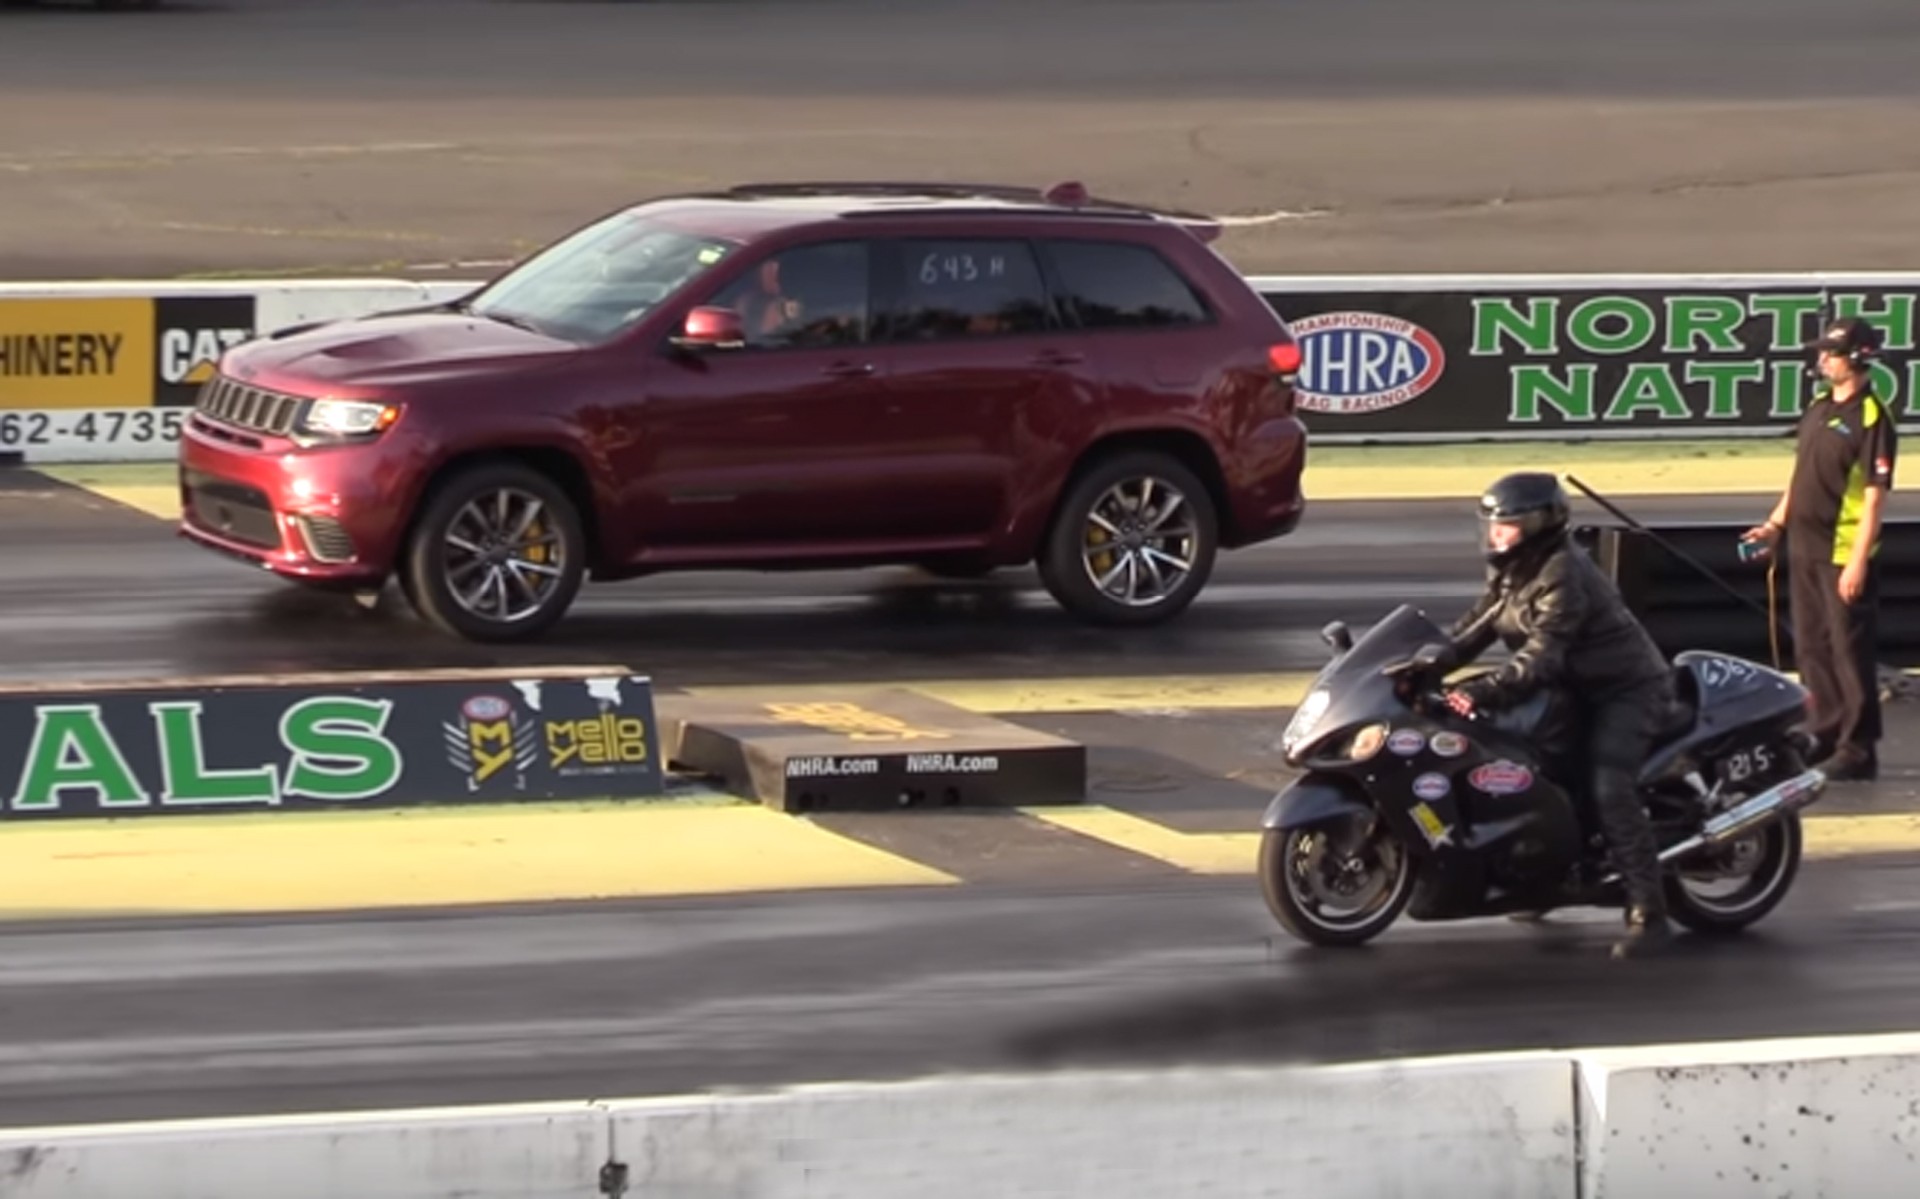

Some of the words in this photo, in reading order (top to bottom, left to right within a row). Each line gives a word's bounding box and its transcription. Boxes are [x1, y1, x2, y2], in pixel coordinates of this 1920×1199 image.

[920, 253, 978, 284] 643
[1292, 313, 1411, 334] HAMPIONSHIP
[1470, 293, 1916, 354] NORTH
[1508, 360, 1920, 421] NATI
[11, 696, 402, 810] ALS
[786, 758, 879, 777] NHRA.com
[907, 754, 999, 773] NHRA.com
